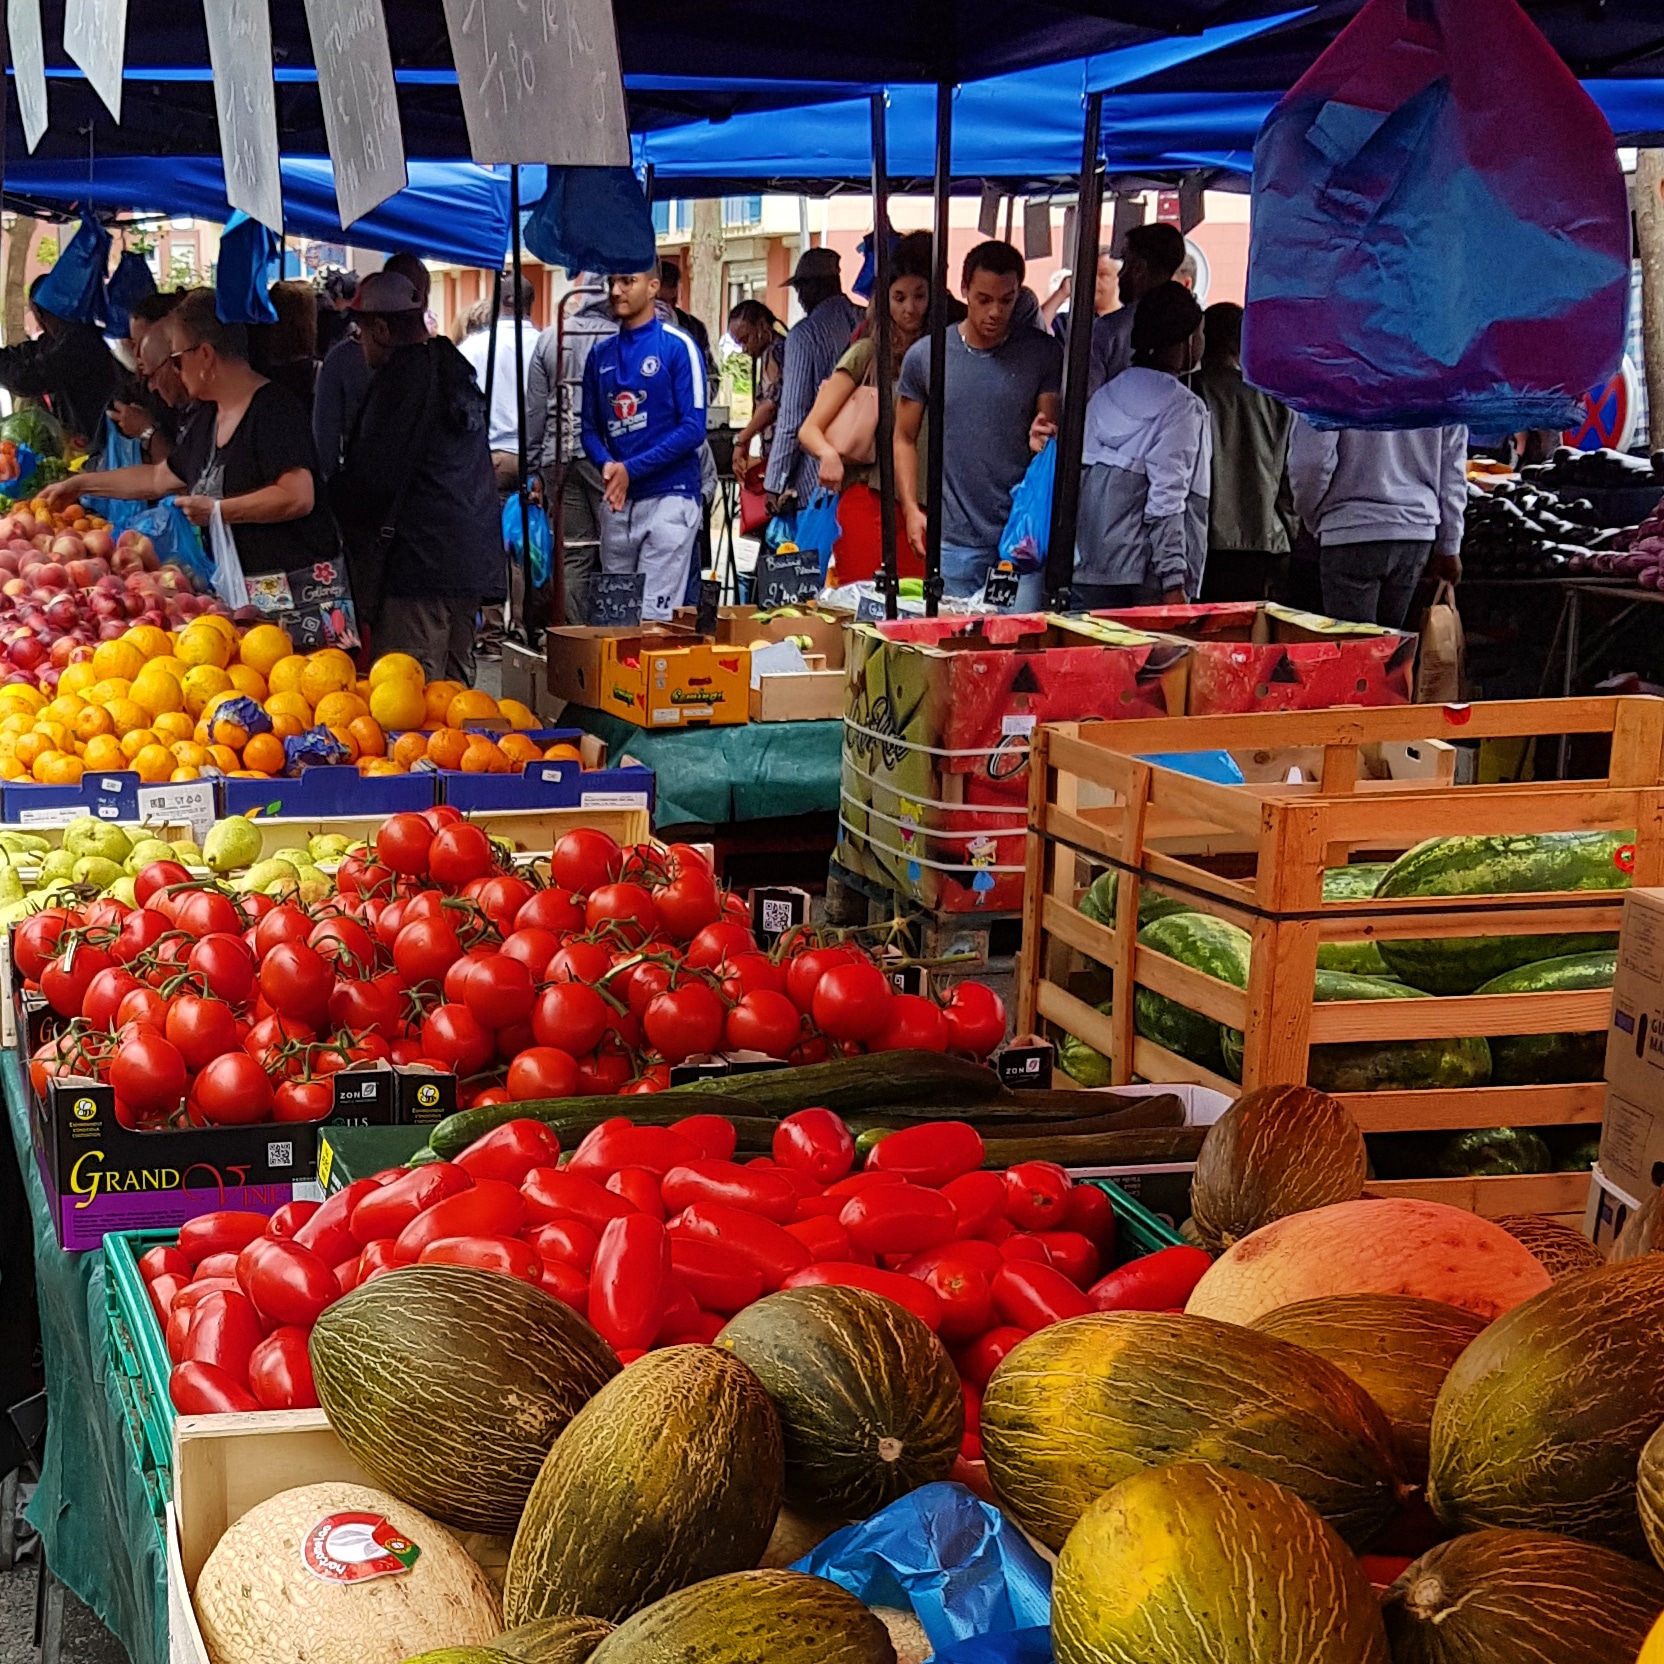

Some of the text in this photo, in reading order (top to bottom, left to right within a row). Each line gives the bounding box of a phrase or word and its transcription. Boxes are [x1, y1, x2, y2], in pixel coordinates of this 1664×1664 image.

[1005, 1066, 1025, 1075] ZON
[339, 1091, 361, 1100] ZON
[70, 1150, 180, 1209] GRAND
